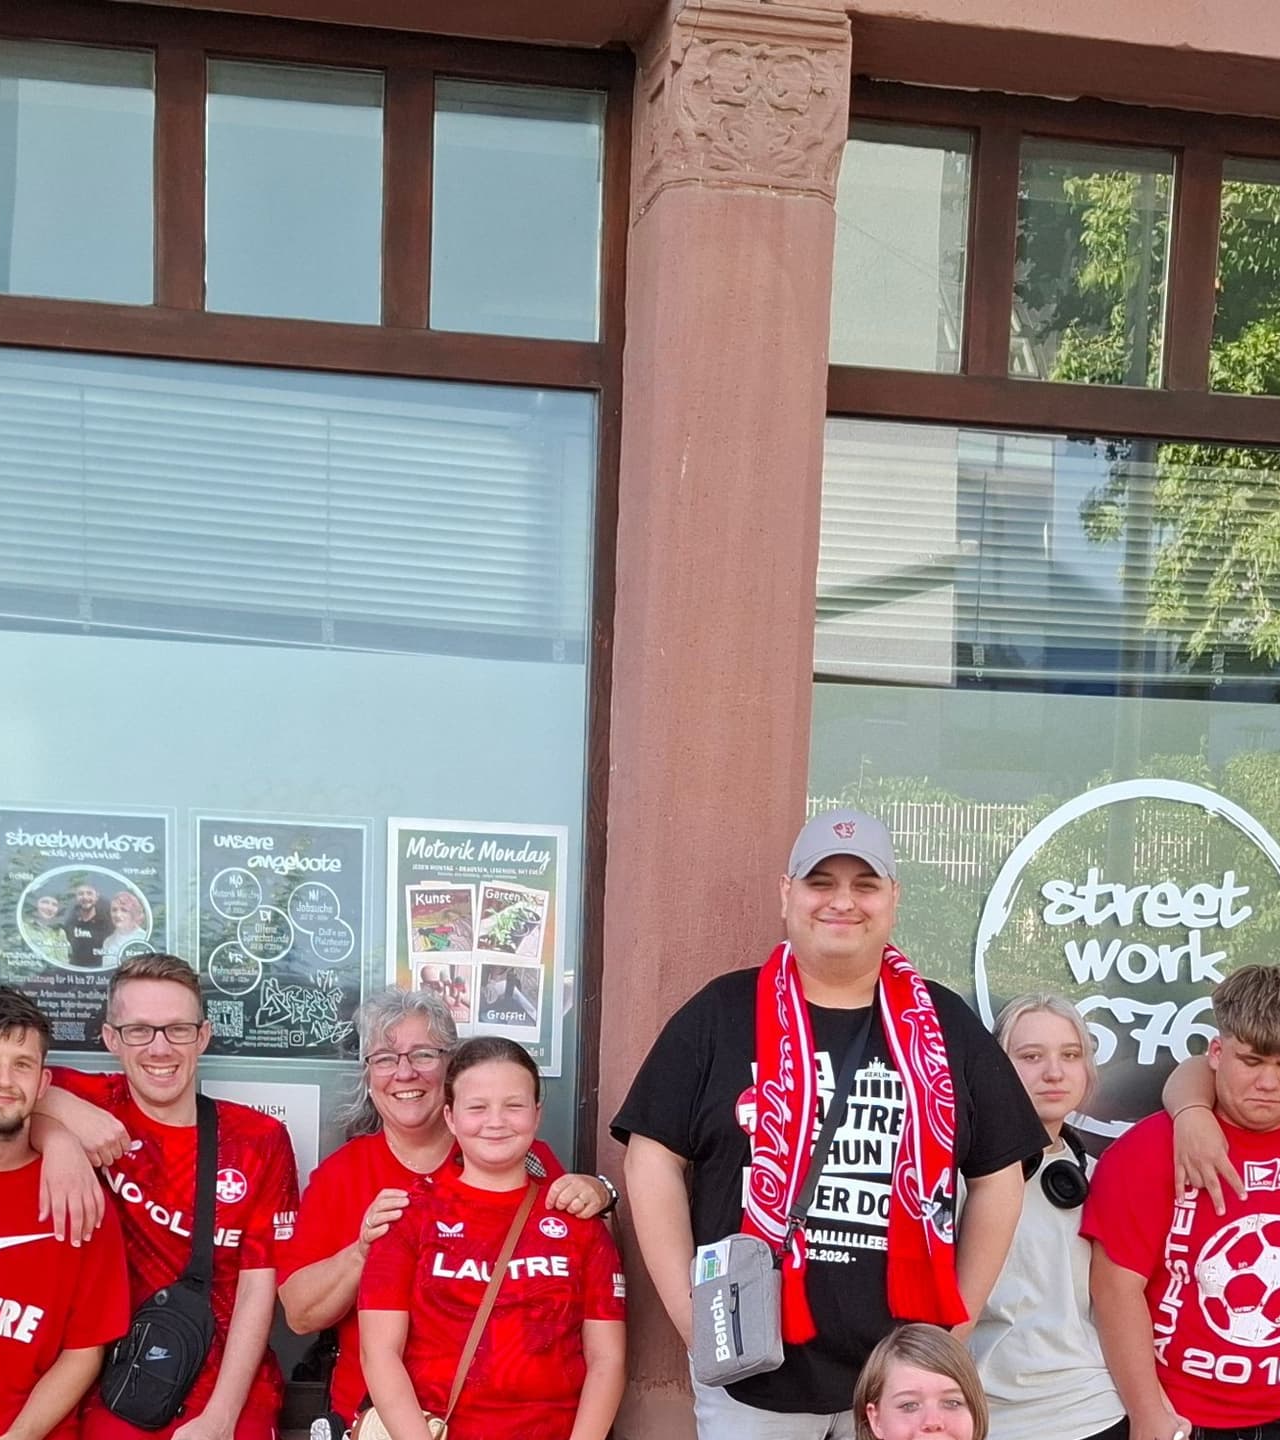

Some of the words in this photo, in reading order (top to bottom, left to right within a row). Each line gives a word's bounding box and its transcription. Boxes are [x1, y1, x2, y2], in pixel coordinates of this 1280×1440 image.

[213, 834, 274, 850] unsere
[406, 837, 473, 861] Motorik
[477, 840, 551, 870] Monday
[247, 852, 342, 875] angebote
[415, 893, 451, 905] Kunst
[1040, 867, 1253, 929] street
[1064, 930, 1227, 985] work
[710, 1289, 731, 1363] Bench.
